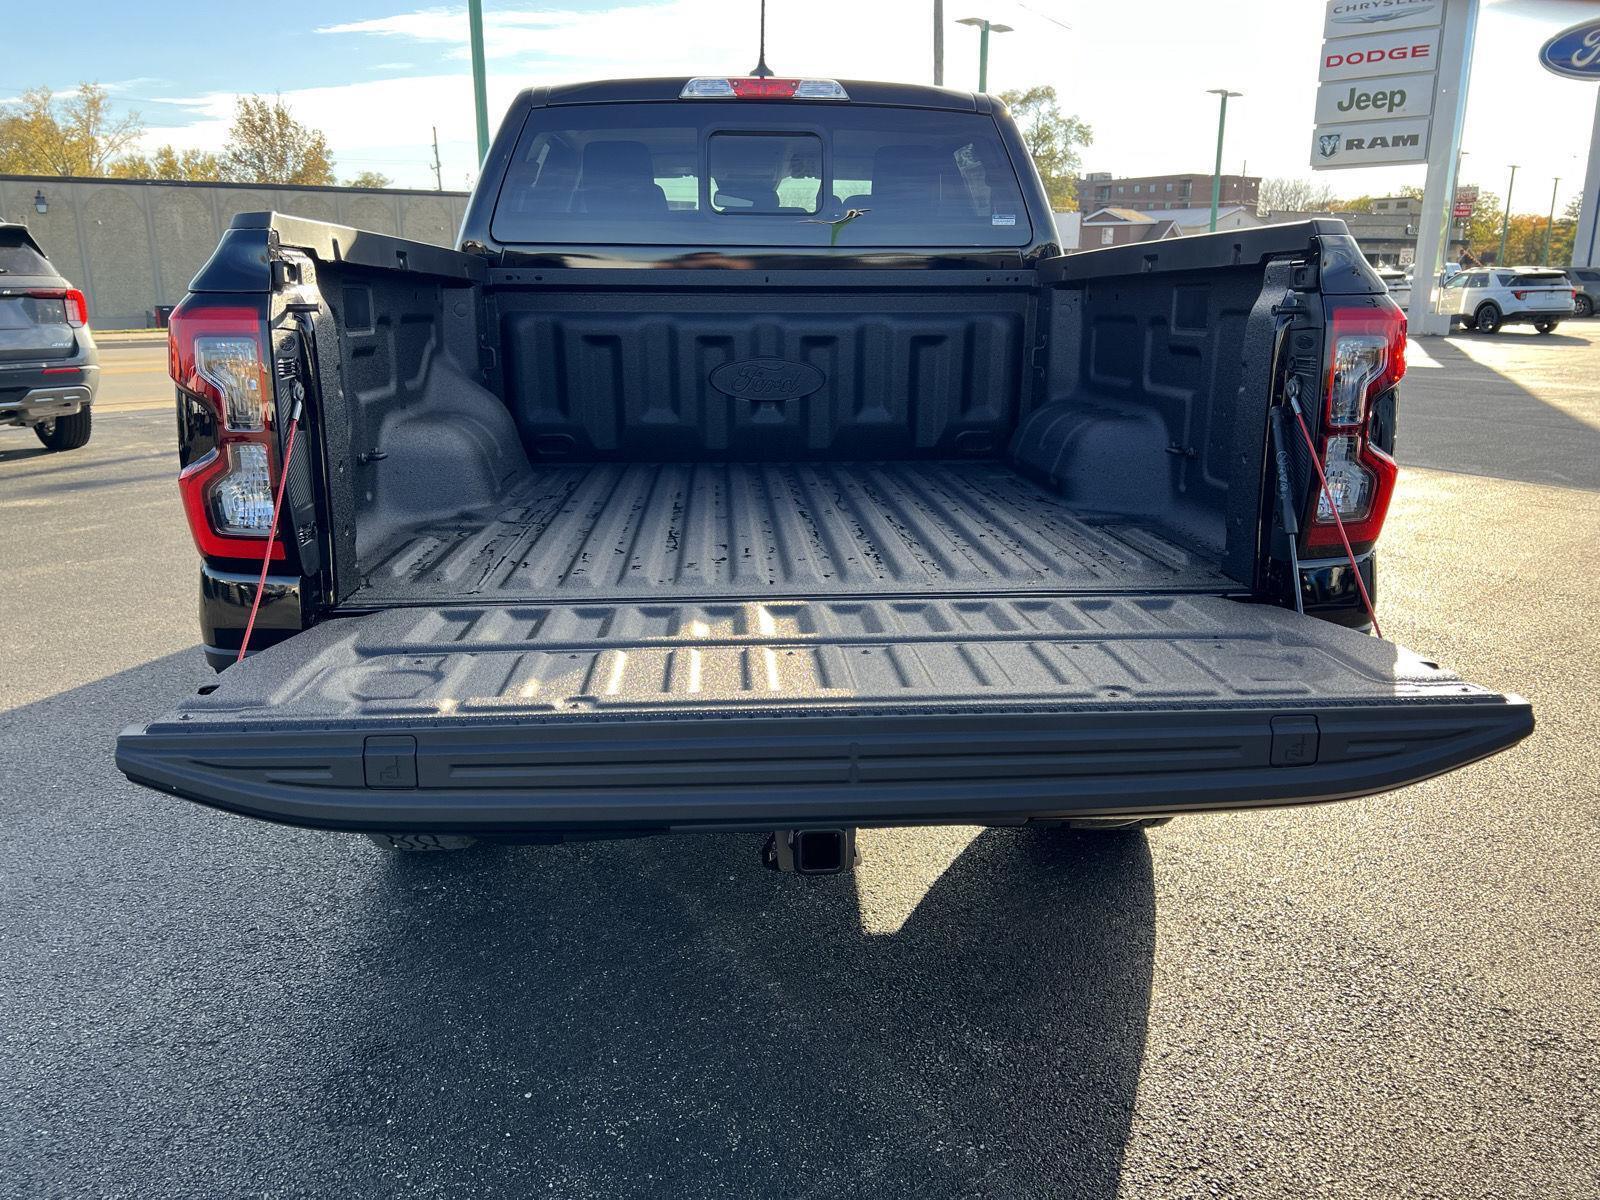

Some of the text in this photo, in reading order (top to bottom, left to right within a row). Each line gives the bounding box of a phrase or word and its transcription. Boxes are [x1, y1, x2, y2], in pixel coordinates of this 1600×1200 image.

[1333, 0, 1434, 14] CHRYSL
[1325, 44, 1430, 68] DODGE
[1337, 87, 1407, 113] Jeep
[1345, 134, 1420, 151] RAM
[731, 364, 801, 393] Ford
